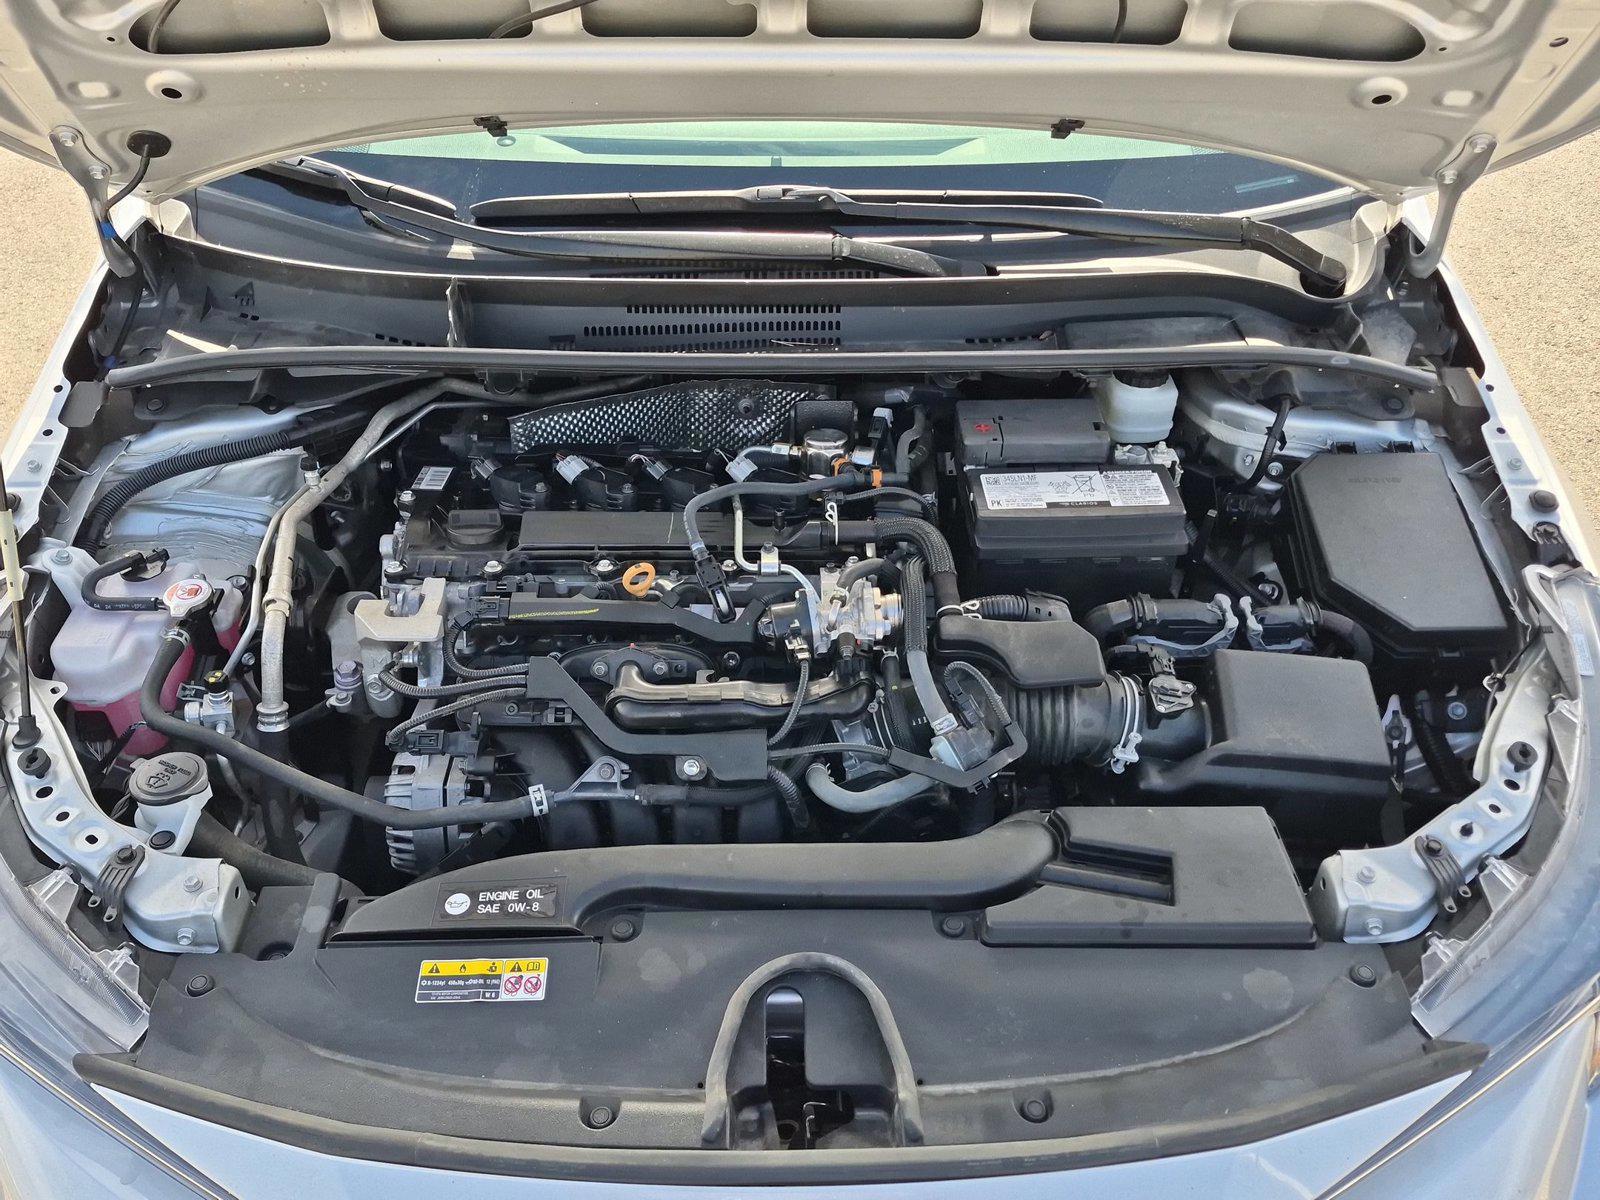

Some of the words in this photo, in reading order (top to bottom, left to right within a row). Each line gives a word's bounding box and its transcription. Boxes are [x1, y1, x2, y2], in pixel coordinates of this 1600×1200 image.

[991, 499, 1002, 507] PK
[479, 890, 519, 902] ENGINE
[526, 889, 544, 899] OIL
[477, 903, 500, 914] SAE
[507, 902, 540, 913] 0W-8
